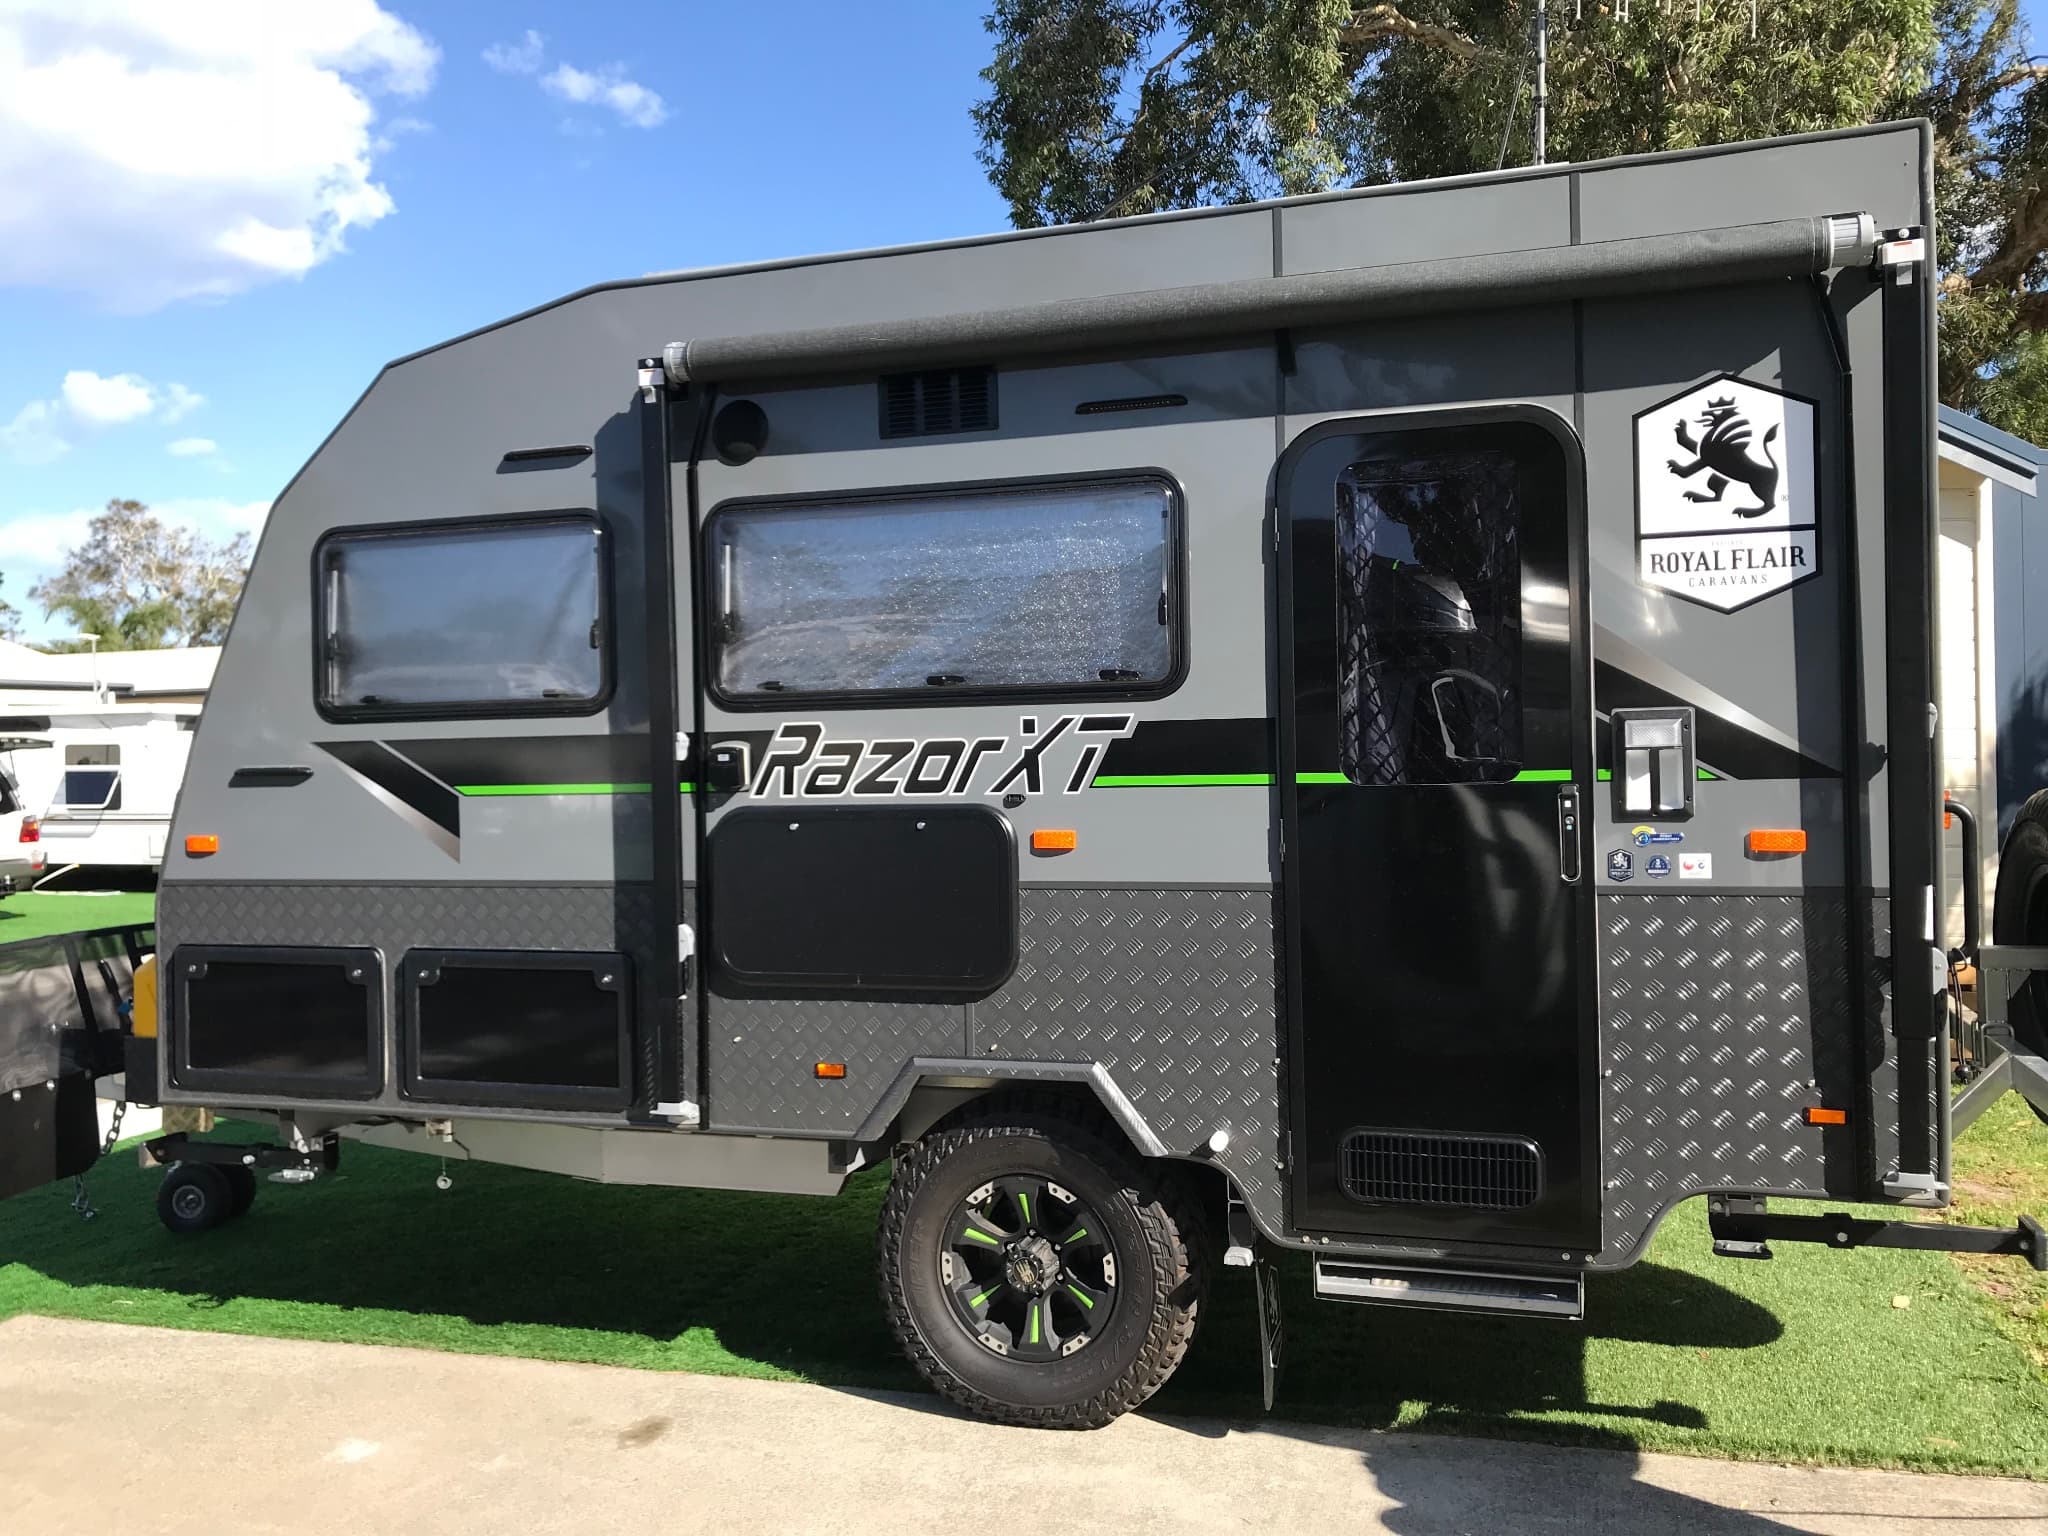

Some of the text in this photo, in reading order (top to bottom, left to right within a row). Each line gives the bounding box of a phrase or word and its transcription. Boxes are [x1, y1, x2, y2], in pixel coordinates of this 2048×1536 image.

[1650, 545, 1807, 574] ROYAL FLAIR
[1688, 574, 1768, 588] CARAVANS
[750, 714, 1134, 798] Razor XT
